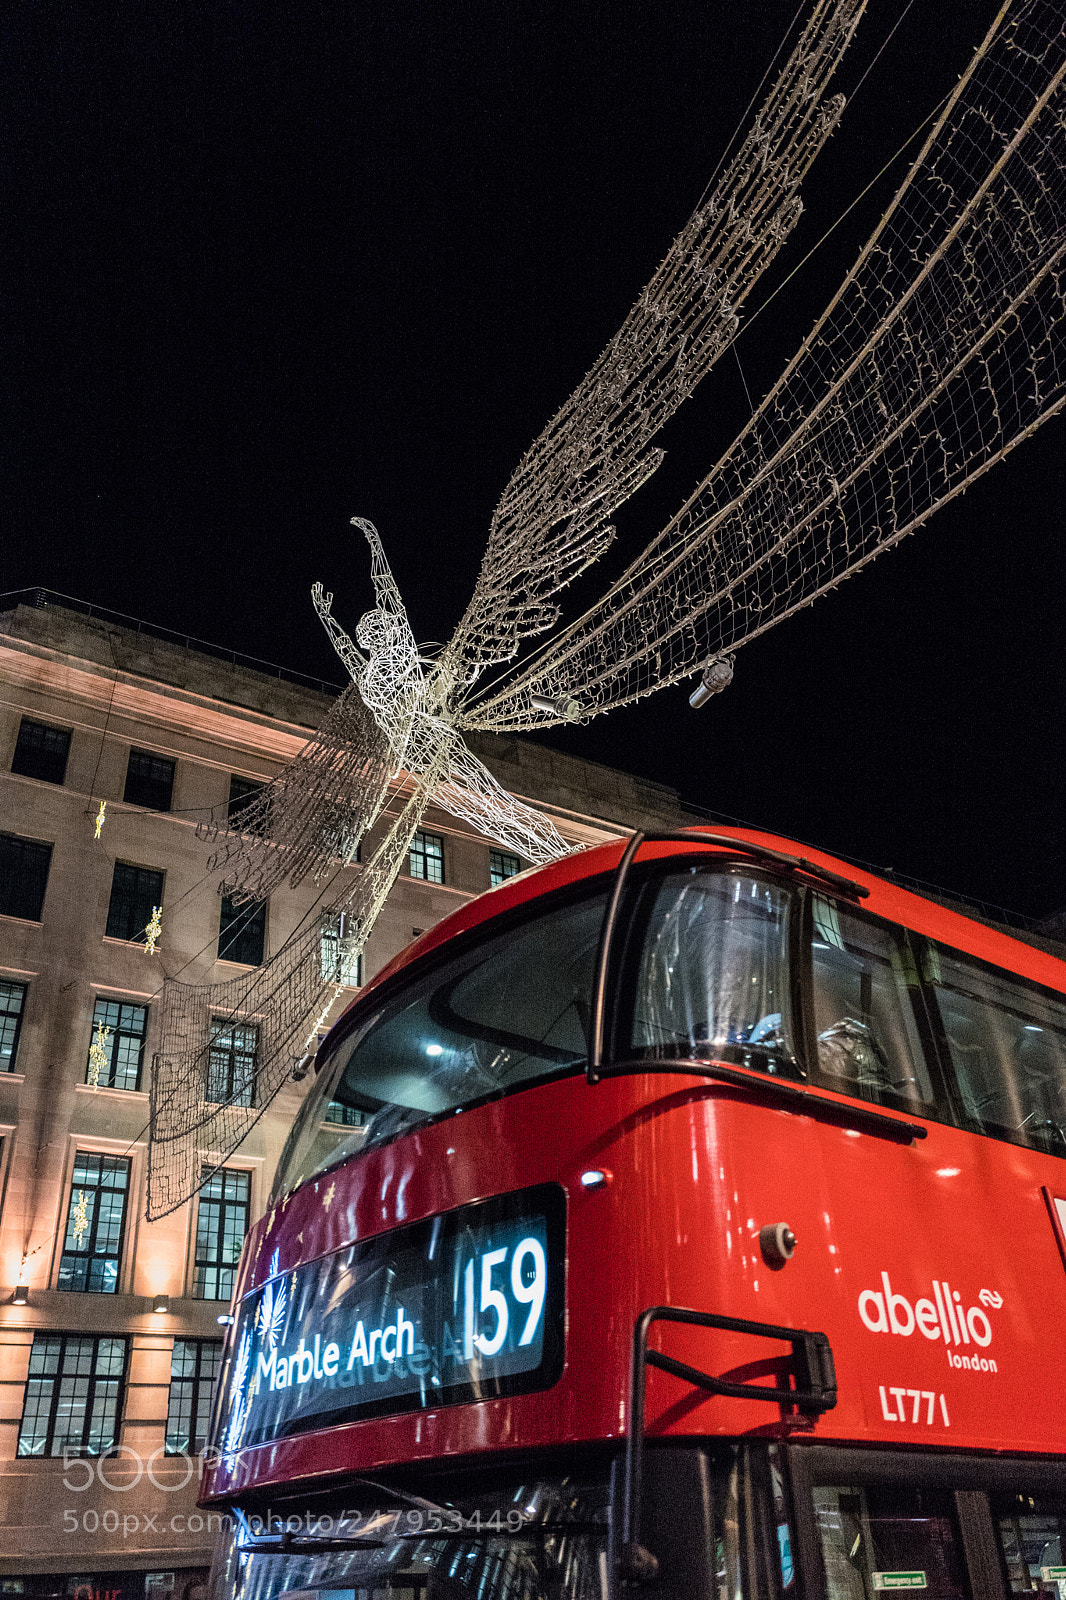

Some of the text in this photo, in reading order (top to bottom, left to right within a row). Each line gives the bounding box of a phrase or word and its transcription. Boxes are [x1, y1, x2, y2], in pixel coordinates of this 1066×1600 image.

[463, 1237, 548, 1360] 159
[857, 1271, 992, 1348] abellio
[254, 1333, 341, 1395] Marble
[346, 1307, 415, 1371] Arch
[947, 1349, 998, 1373] london
[878, 1385, 950, 1427] LT771
